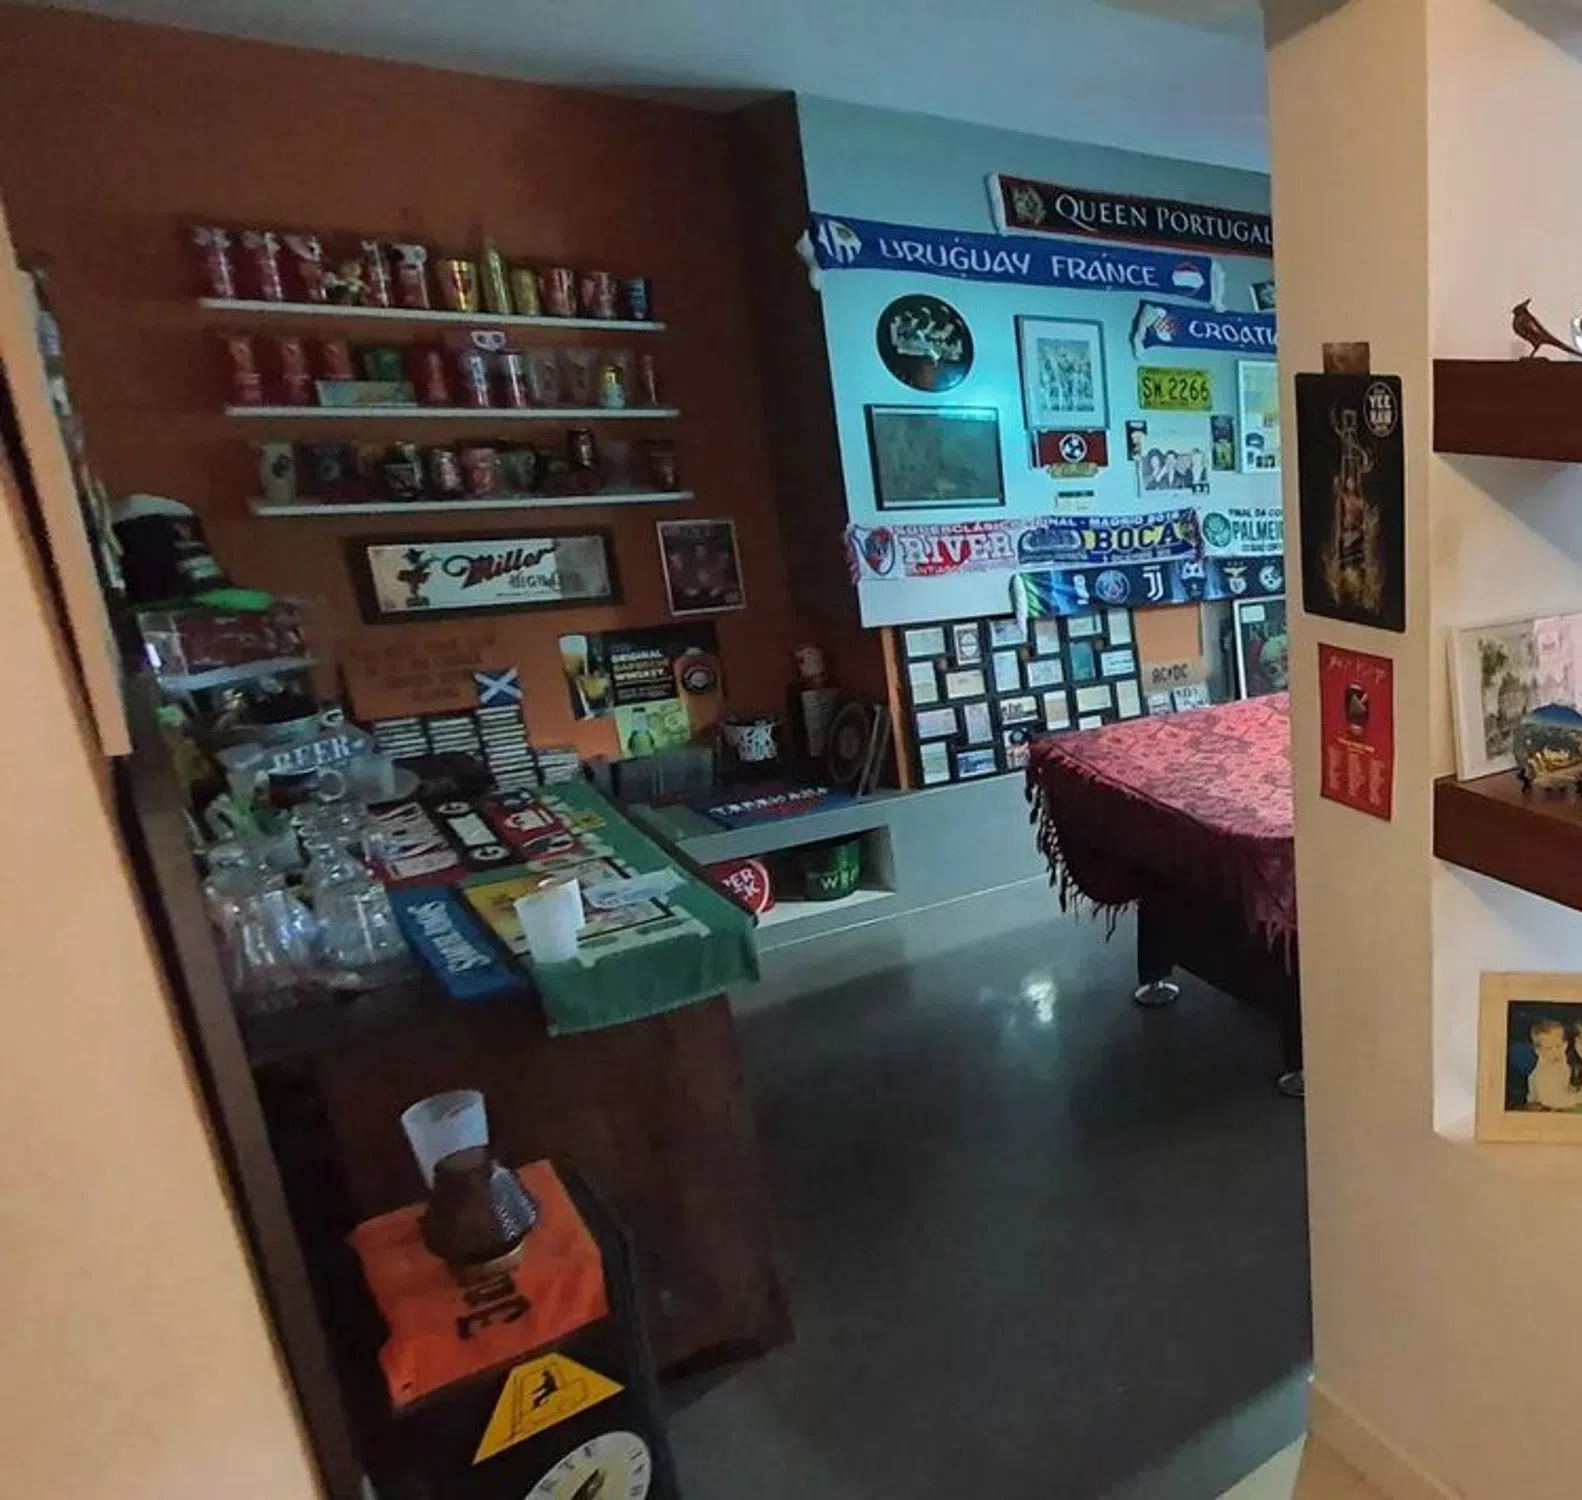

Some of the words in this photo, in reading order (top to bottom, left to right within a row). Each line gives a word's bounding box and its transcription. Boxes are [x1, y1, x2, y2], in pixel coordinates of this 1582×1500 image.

[1055, 194, 1148, 232] QUEEN
[1156, 206, 1273, 244] PORTUGAL
[878, 237, 1031, 276] URUGUAY
[1051, 255, 1160, 287] FRANCE
[1189, 320, 1278, 346] CROATI
[903, 531, 1015, 564] RIVER
[1093, 523, 1181, 552] BOCA
[442, 542, 561, 589] Miller
